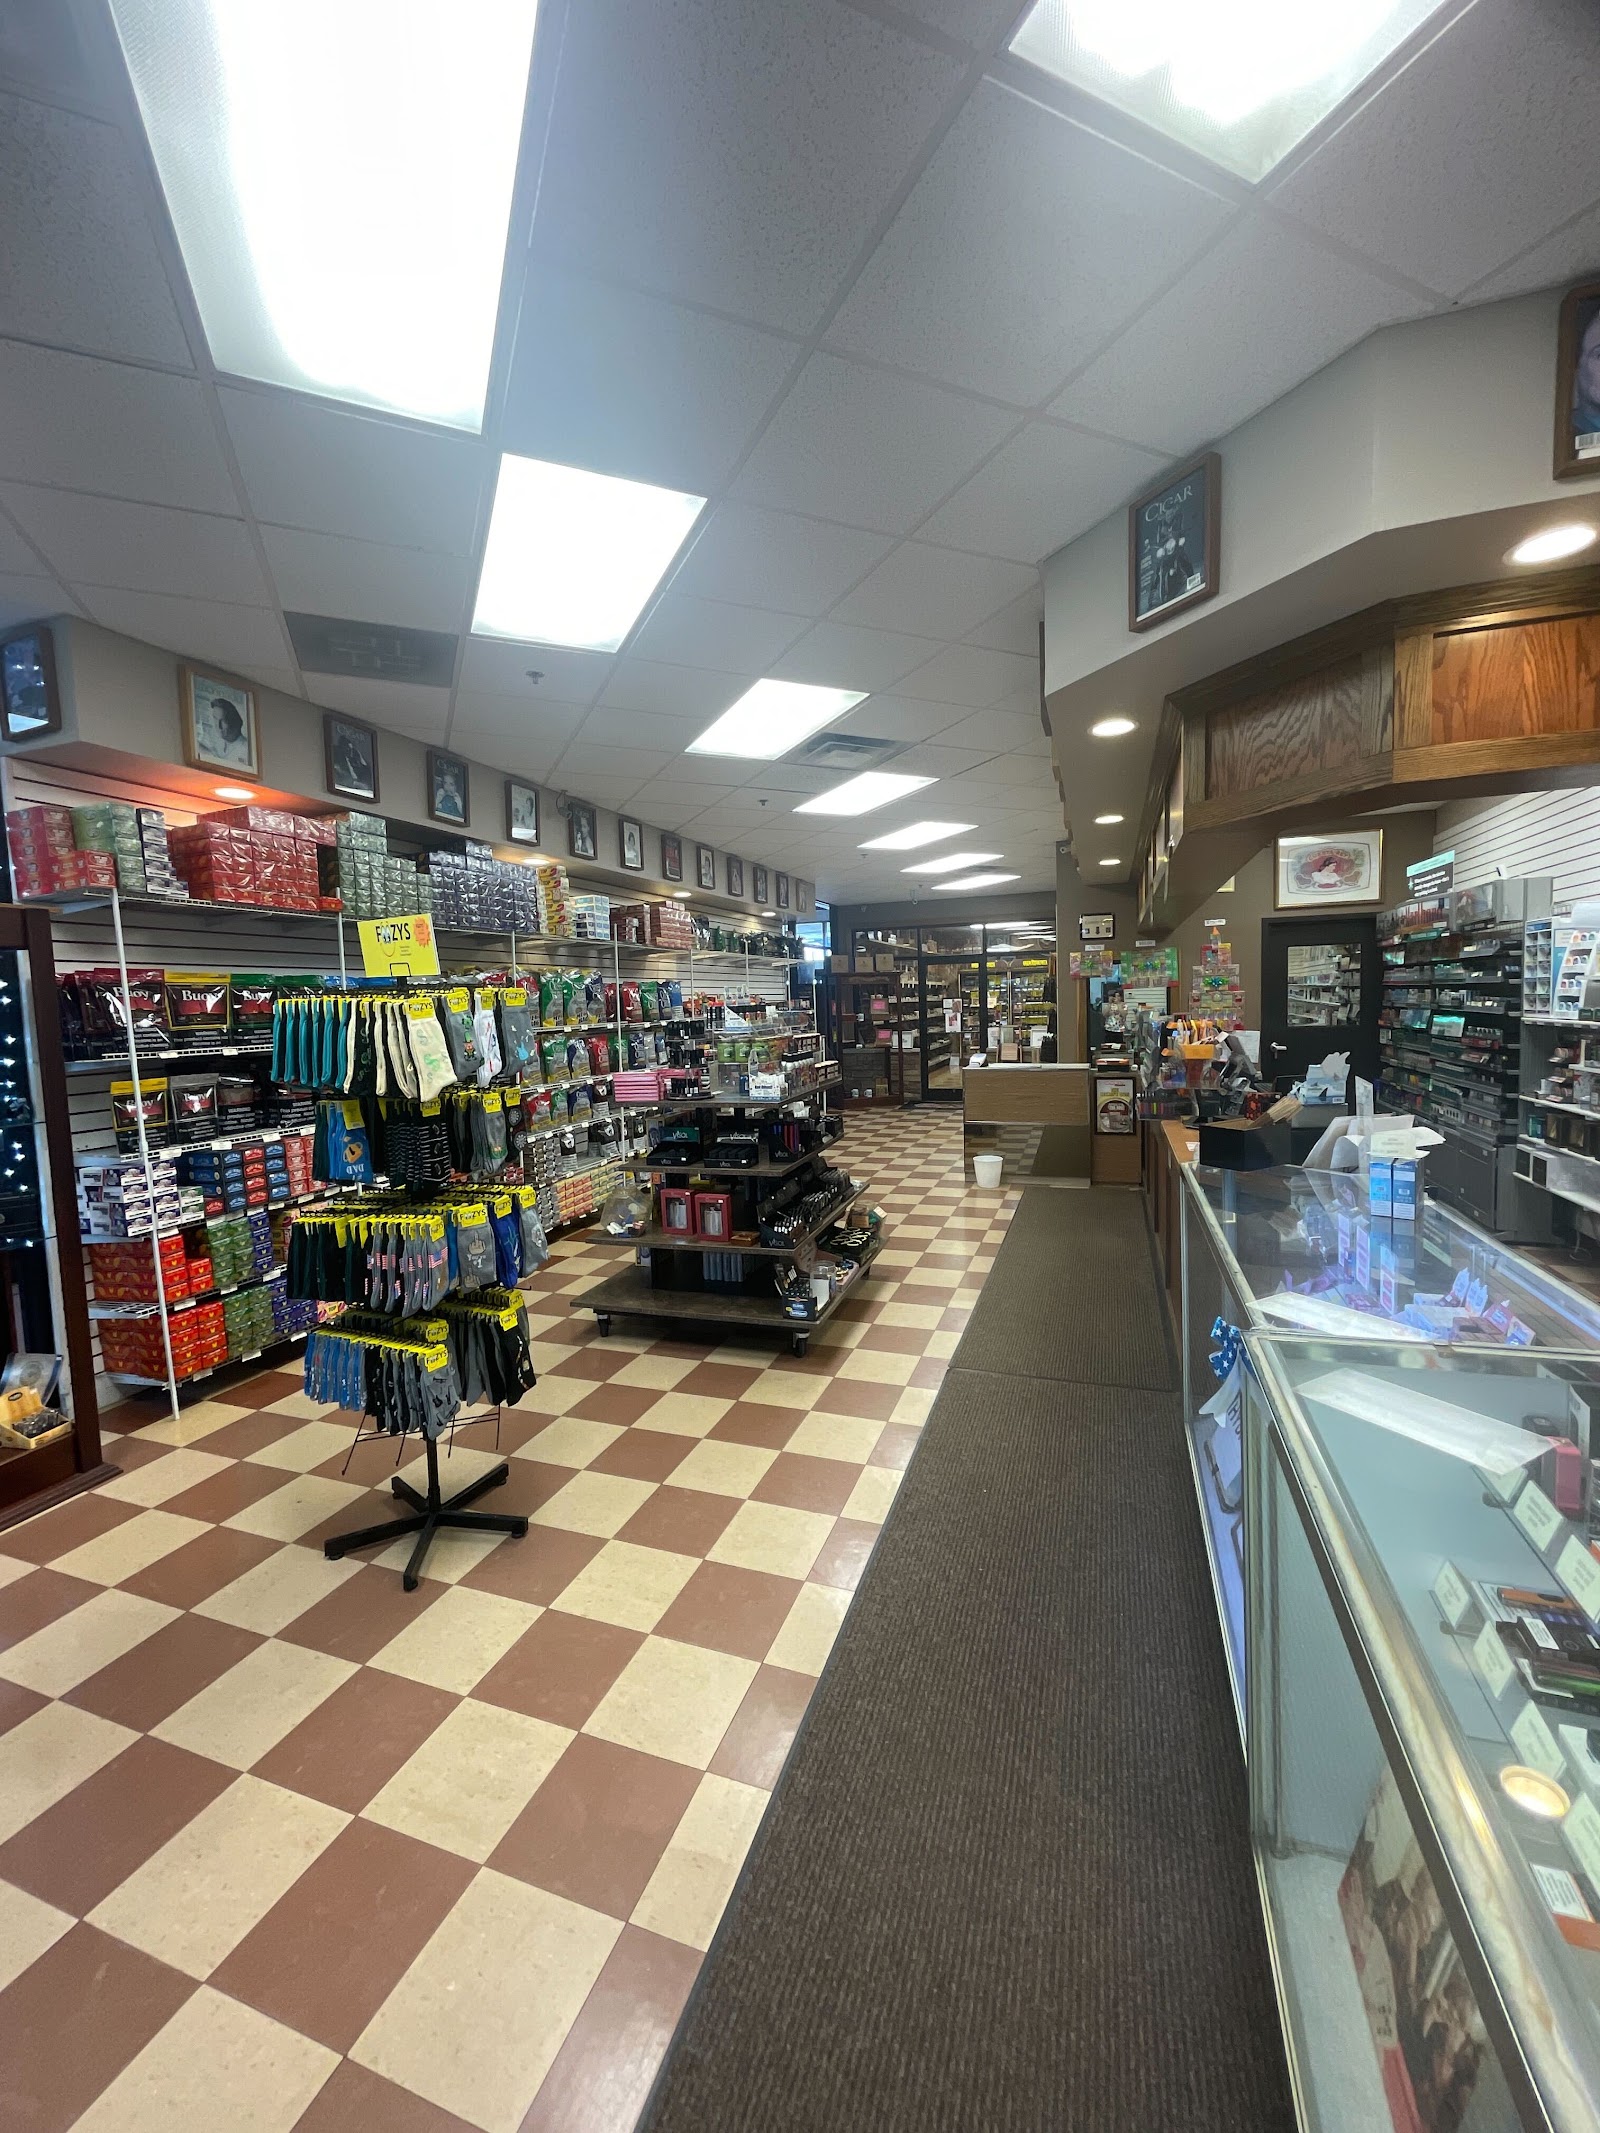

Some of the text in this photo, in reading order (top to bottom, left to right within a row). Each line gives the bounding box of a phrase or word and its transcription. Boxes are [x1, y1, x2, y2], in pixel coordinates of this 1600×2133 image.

[1145, 485, 1193, 522] CIGAR
[436, 758, 461, 775] CIGAR
[126, 1100, 154, 1109] Boy
[346, 1163, 365, 1175] DAD
